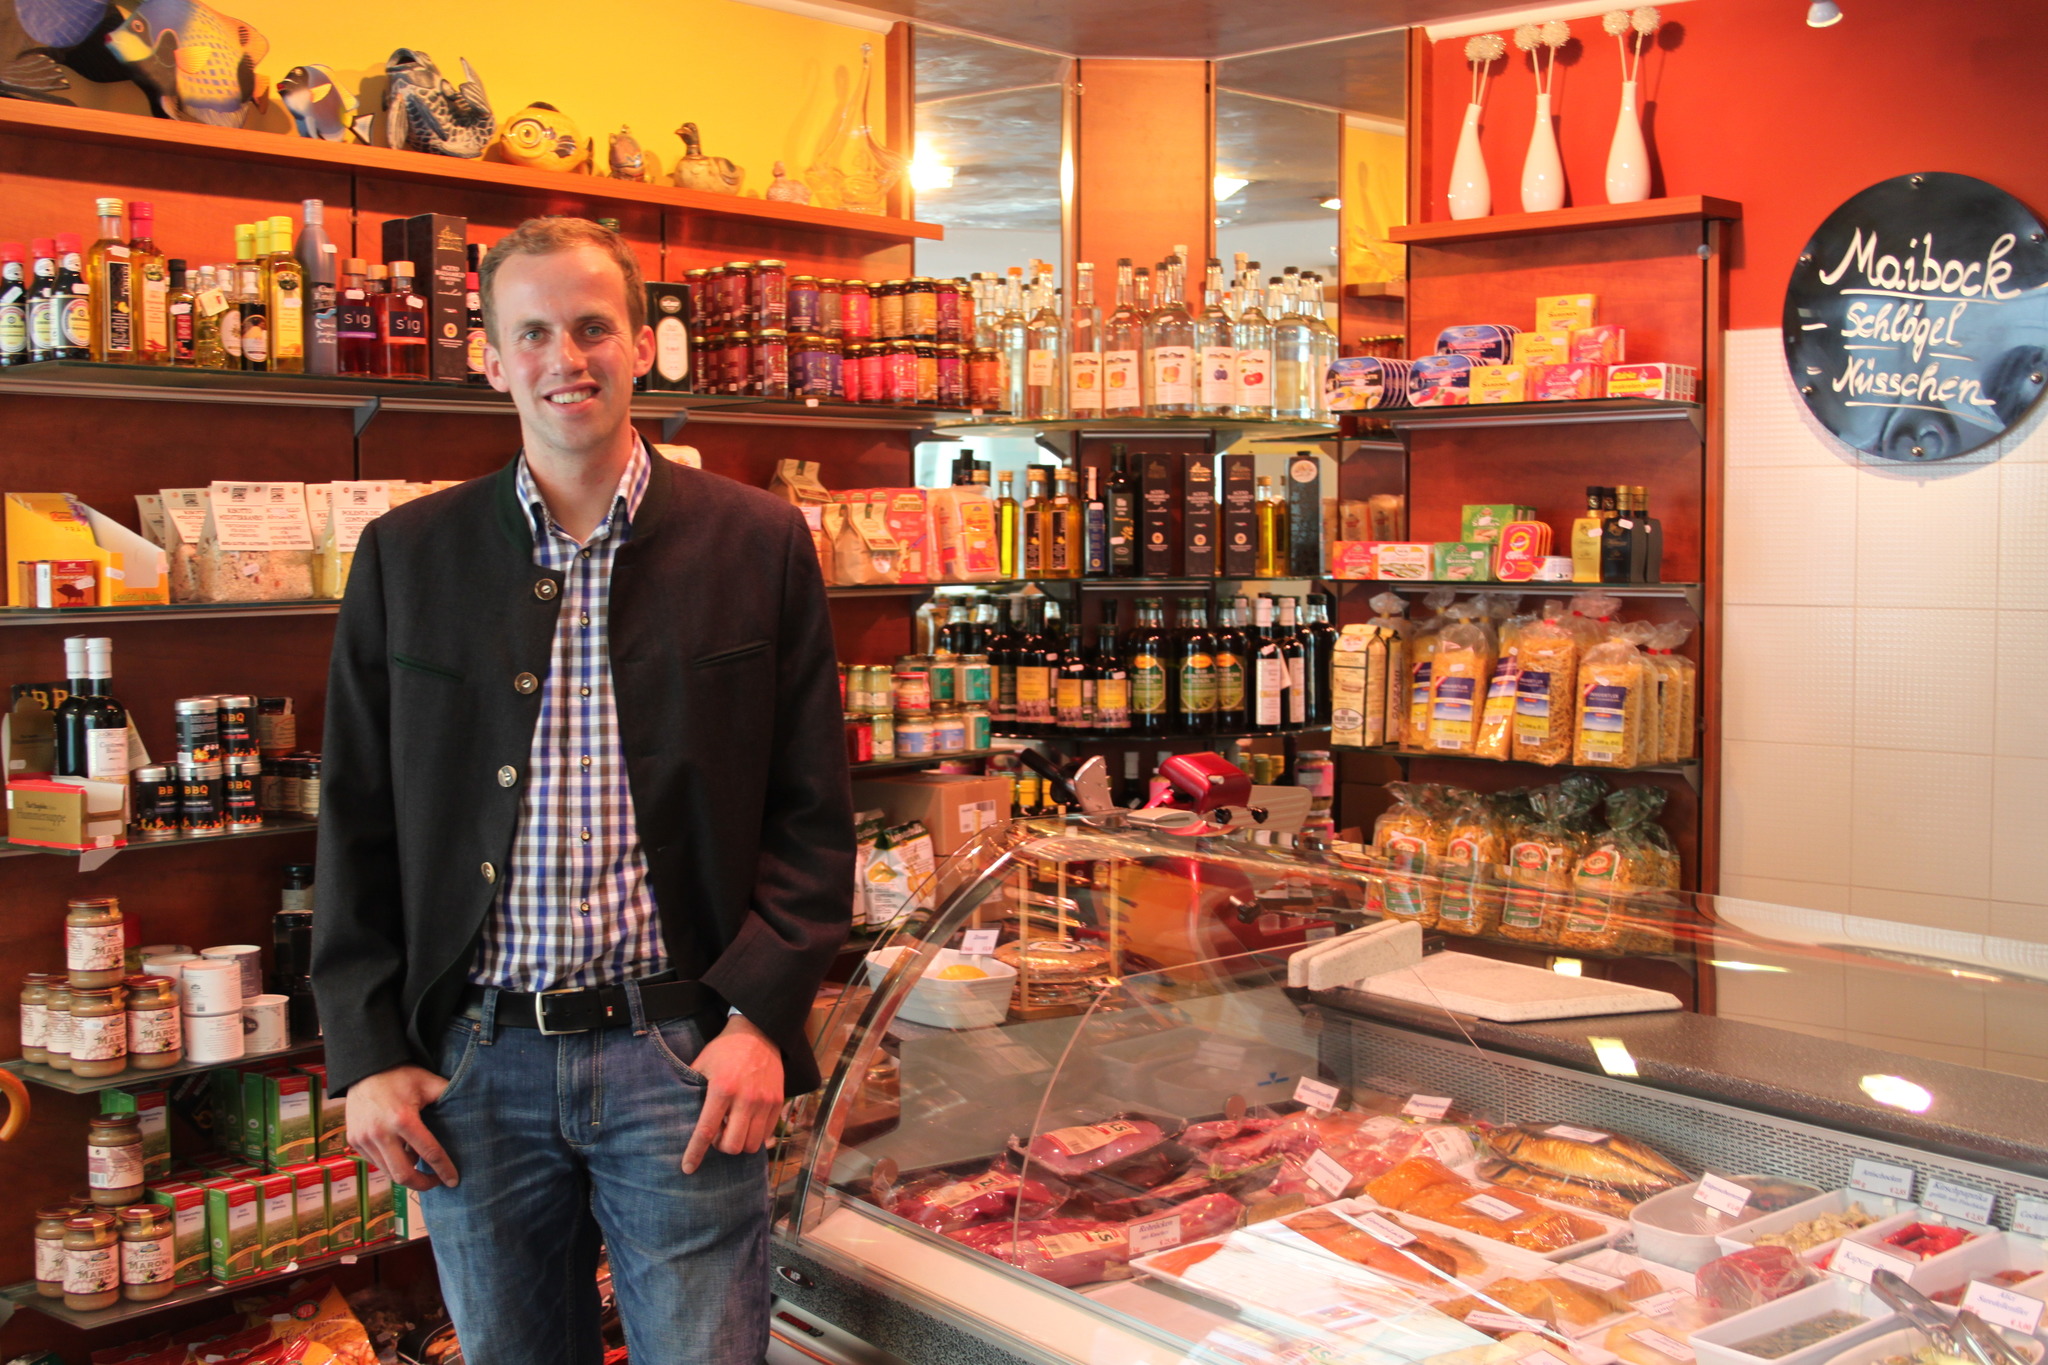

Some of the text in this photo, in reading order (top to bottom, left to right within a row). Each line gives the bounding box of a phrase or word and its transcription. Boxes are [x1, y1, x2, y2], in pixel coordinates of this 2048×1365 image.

[1819, 226, 2022, 300] Maibock
[1832, 355, 1997, 406] Nüsschen
[221, 713, 245, 723] BBQ
[183, 785, 209, 795] BBQ
[228, 780, 252, 791] BBQ
